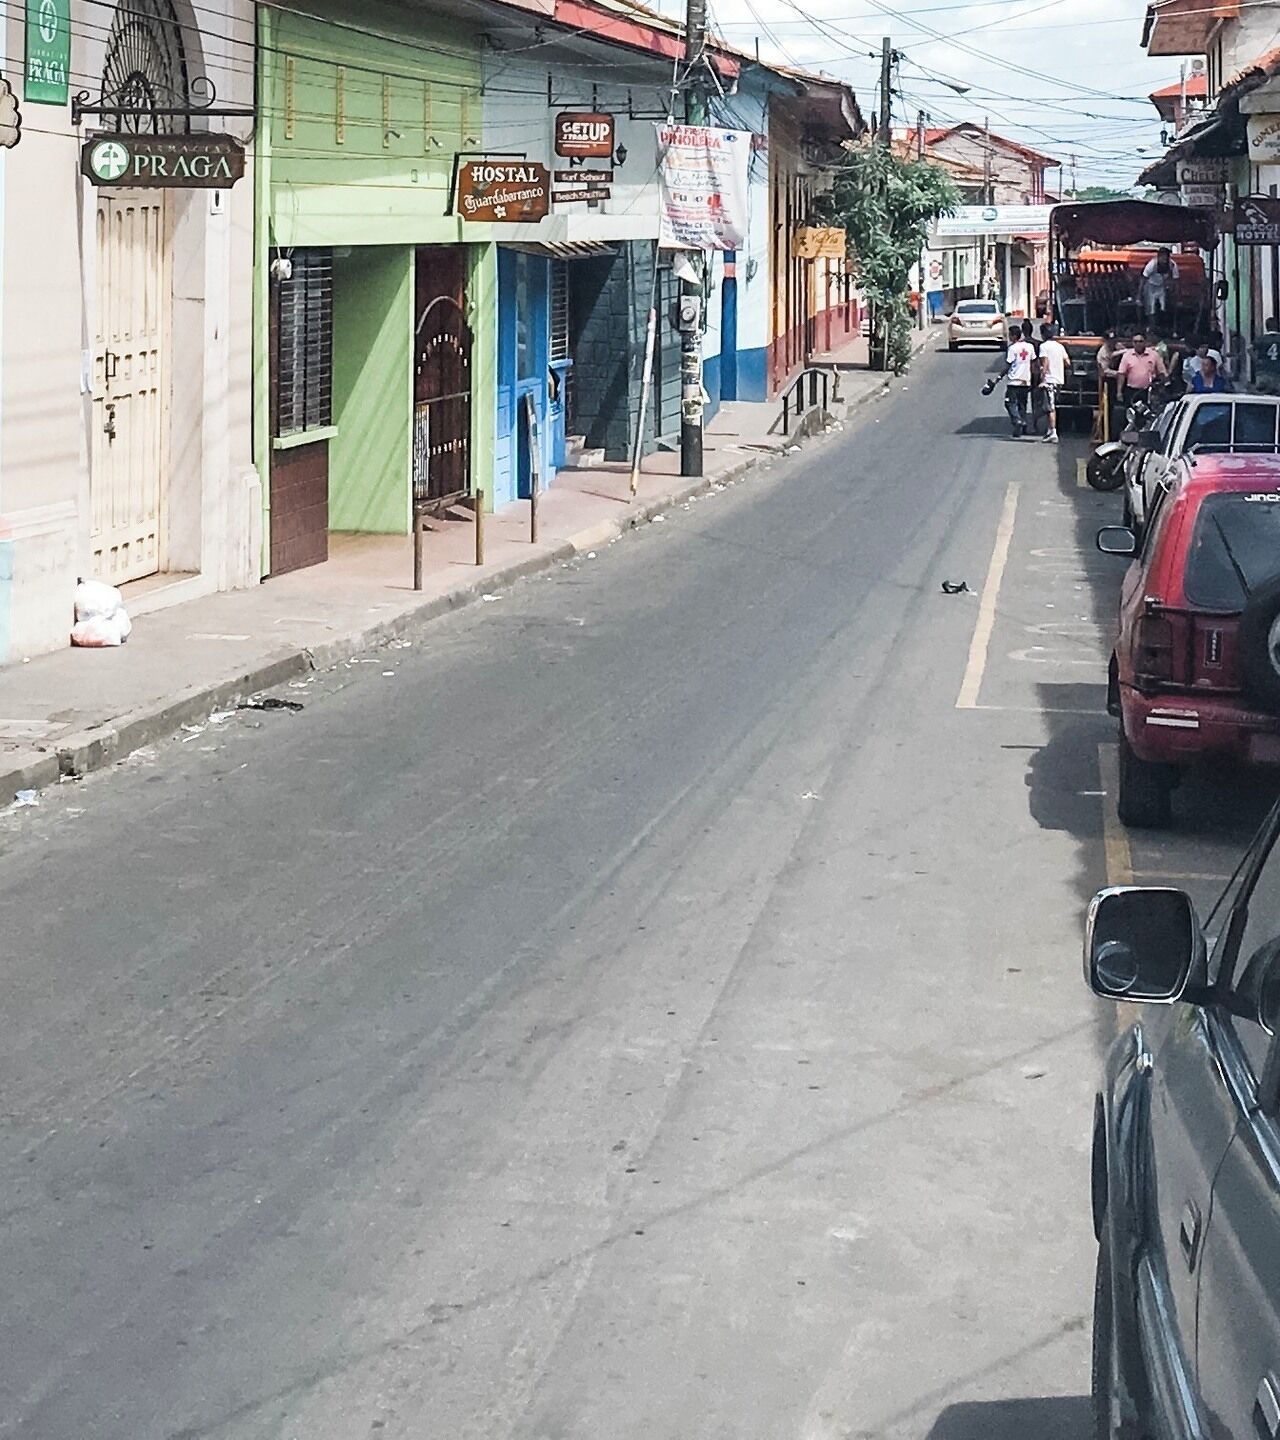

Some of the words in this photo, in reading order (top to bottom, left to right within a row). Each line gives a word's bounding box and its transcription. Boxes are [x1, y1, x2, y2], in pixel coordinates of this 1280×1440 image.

[28, 57, 66, 86] PRAGA
[562, 122, 589, 134] GET
[589, 123, 610, 141] UP
[133, 154, 233, 178] PRAGA
[471, 166, 540, 183] HOSTAL
[580, 172, 606, 181] School
[463, 187, 544, 214] Guardabarranco
[1236, 231, 1280, 240] HOSTEL
[1267, 343, 1279, 361] 4
